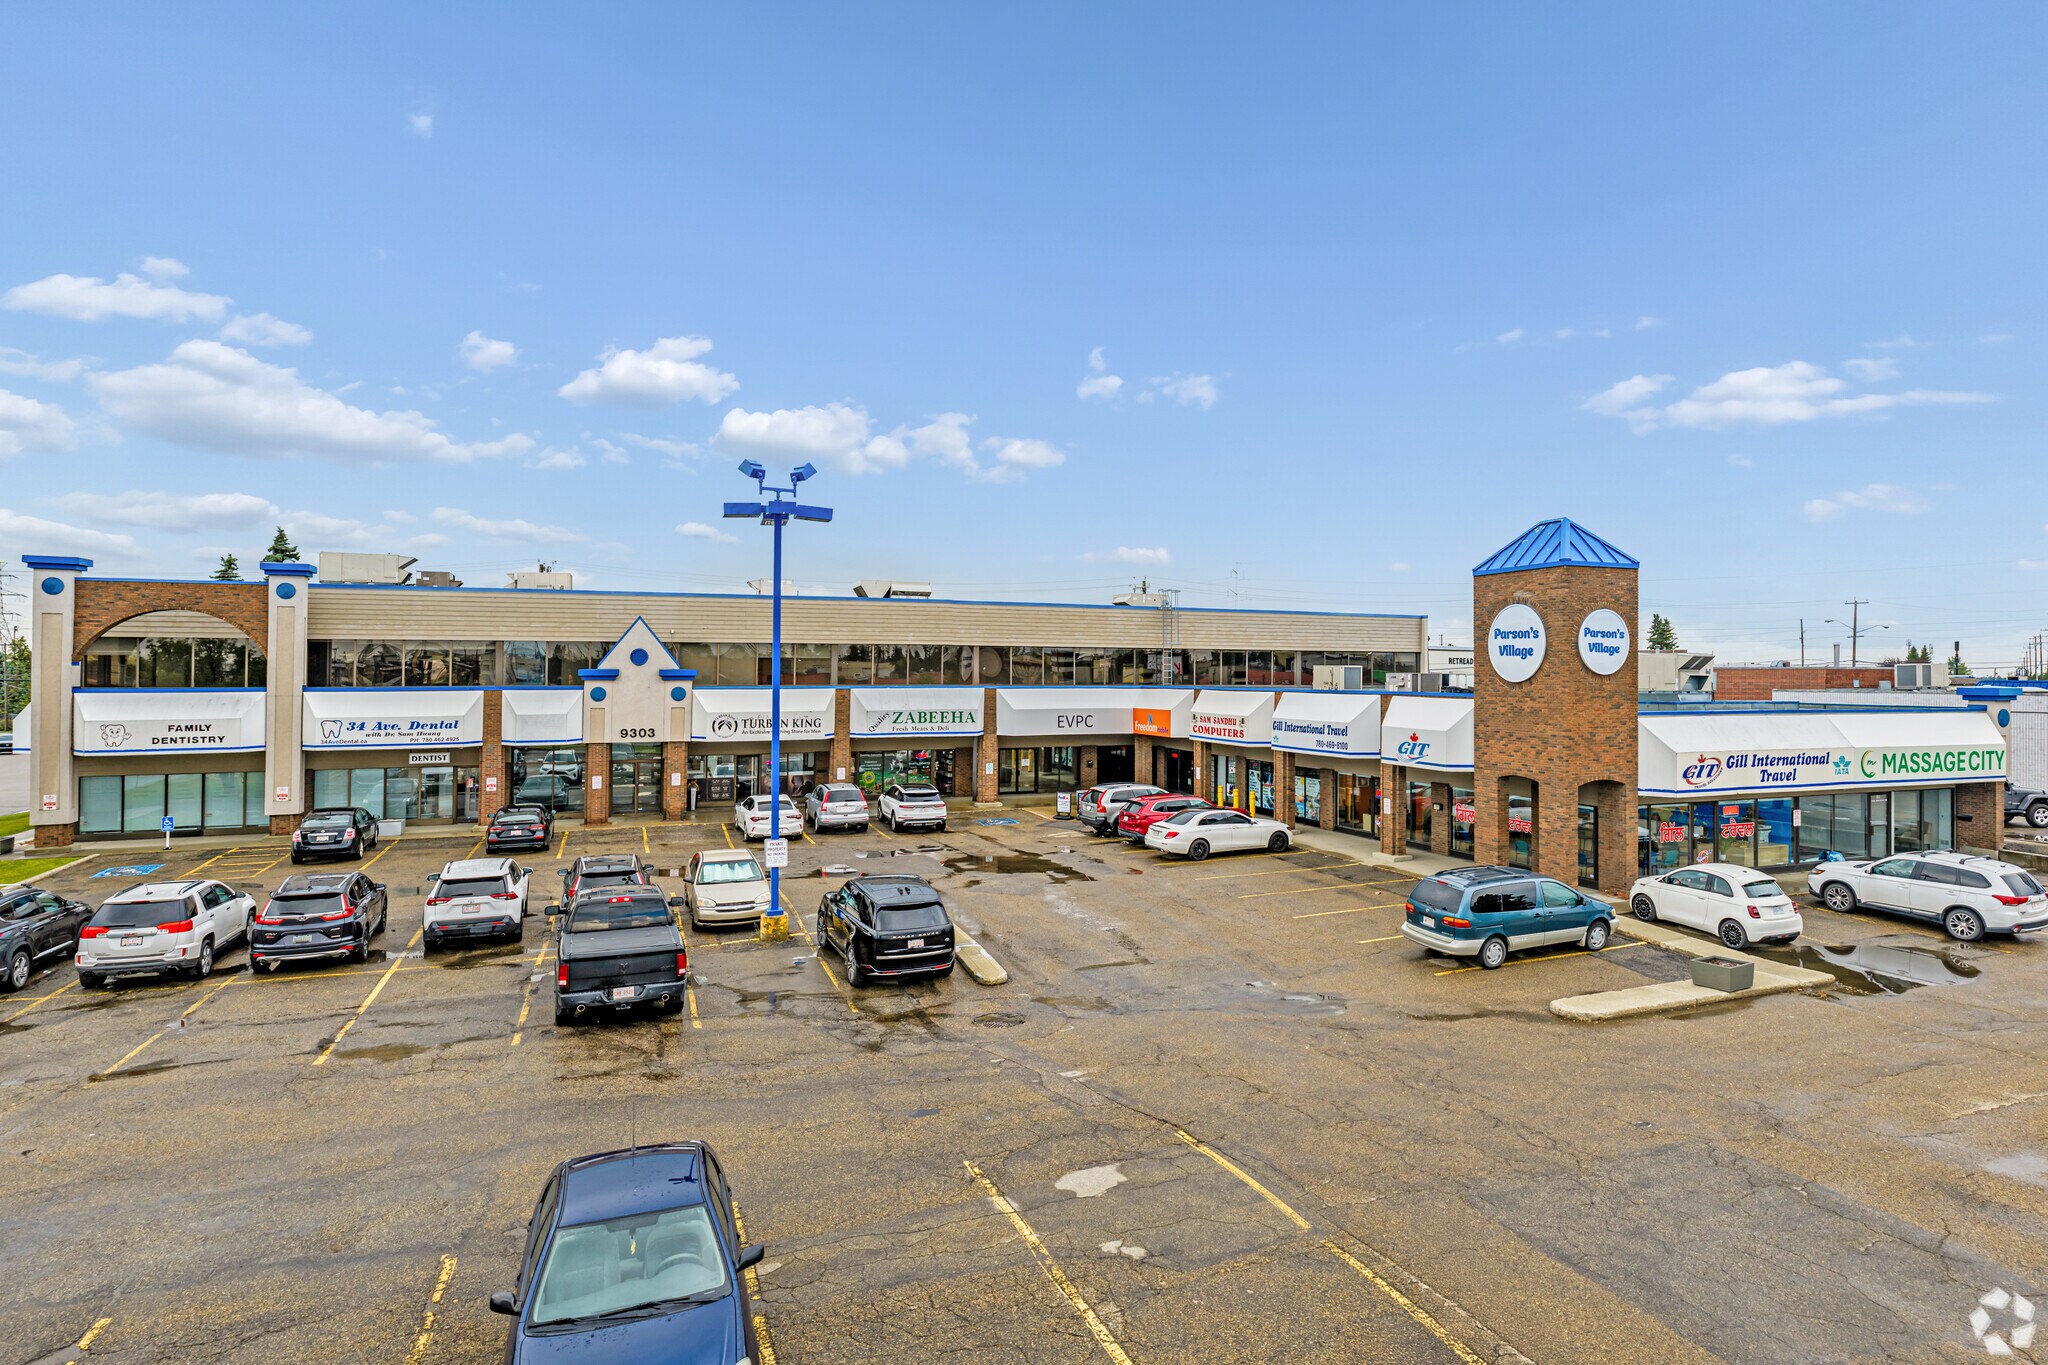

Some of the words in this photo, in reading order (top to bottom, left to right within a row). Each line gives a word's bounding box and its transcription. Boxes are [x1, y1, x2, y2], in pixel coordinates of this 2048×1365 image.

[1493, 627, 1540, 640] Parson's
[1583, 627, 1625, 639] Parson's
[1498, 645, 1534, 660] Village
[1588, 643, 1620, 656] Village
[1448, 657, 1474, 665] RETREAD
[741, 718, 788, 729] TURBN
[792, 717, 822, 729] KING
[868, 711, 890, 733] Quality
[892, 711, 976, 724] ZABEEHA
[1057, 714, 1094, 728] EVPC
[1199, 715, 1211, 723] SAM
[1213, 716, 1237, 726] SANDHU
[168, 724, 212, 732] FAMILY
[346, 721, 366, 731] 34
[371, 721, 402, 731] Ave.
[408, 720, 459, 731] Dental
[1134, 720, 1158, 733] Freedom
[1192, 724, 1245, 738] COMPUTERS
[1272, 720, 1283, 731] Gill
[1284, 721, 1326, 735] International
[1327, 724, 1348, 737] Travel
[620, 728, 656, 738] 9303
[152, 736, 225, 745] DENTISTRY
[1397, 741, 1430, 757] GIT
[411, 754, 448, 762] DENTIST
[1726, 754, 1749, 769] Gill
[1751, 751, 1831, 768] International
[1882, 751, 1967, 774] MASSAGE
[1968, 750, 2005, 771] CITY
[1682, 763, 1719, 780] GIT
[1759, 768, 1797, 783] Travel
[1834, 768, 1850, 776] IATA
[1659, 821, 1685, 843] ਗਿੱਲ
